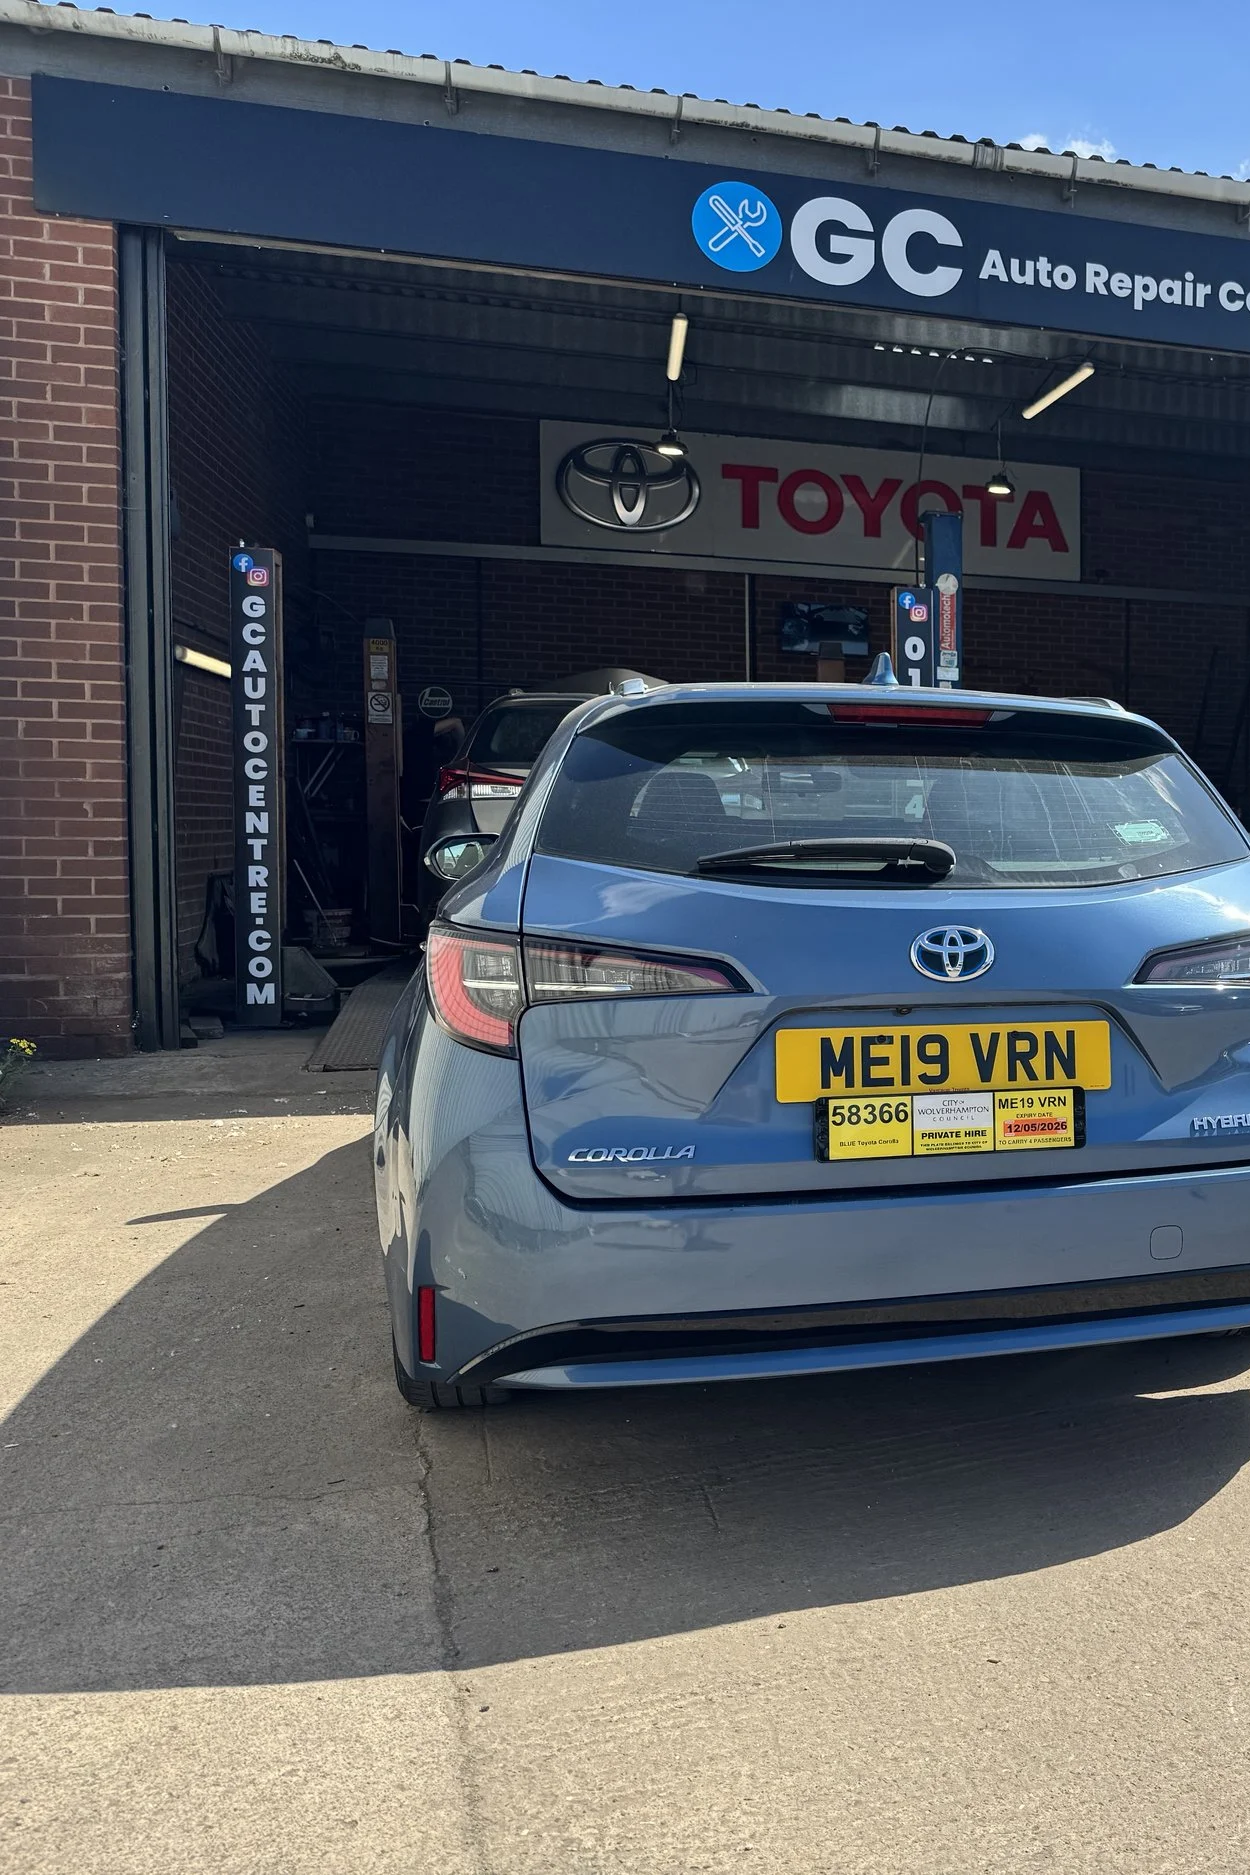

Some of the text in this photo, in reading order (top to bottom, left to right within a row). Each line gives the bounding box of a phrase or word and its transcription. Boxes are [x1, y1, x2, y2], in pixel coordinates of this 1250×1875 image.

[790, 196, 964, 297] GC
[979, 249, 1077, 290] Auto
[1086, 262, 1211, 310] Repair
[722, 463, 1069, 553] TOYOTA
[241, 595, 275, 1005] GCAUTOCENTRE.COM
[820, 1030, 1077, 1089] ME19 VRN
[918, 1106, 990, 1115] WOLVERHAMPTON
[998, 1096, 1067, 1110] ME19 VRN
[831, 1102, 909, 1126] 58366
[921, 1130, 987, 1140] PRIVATE HIRE
[1007, 1121, 1068, 1133] 12/05/2026
[567, 1144, 697, 1162] COROLLA
